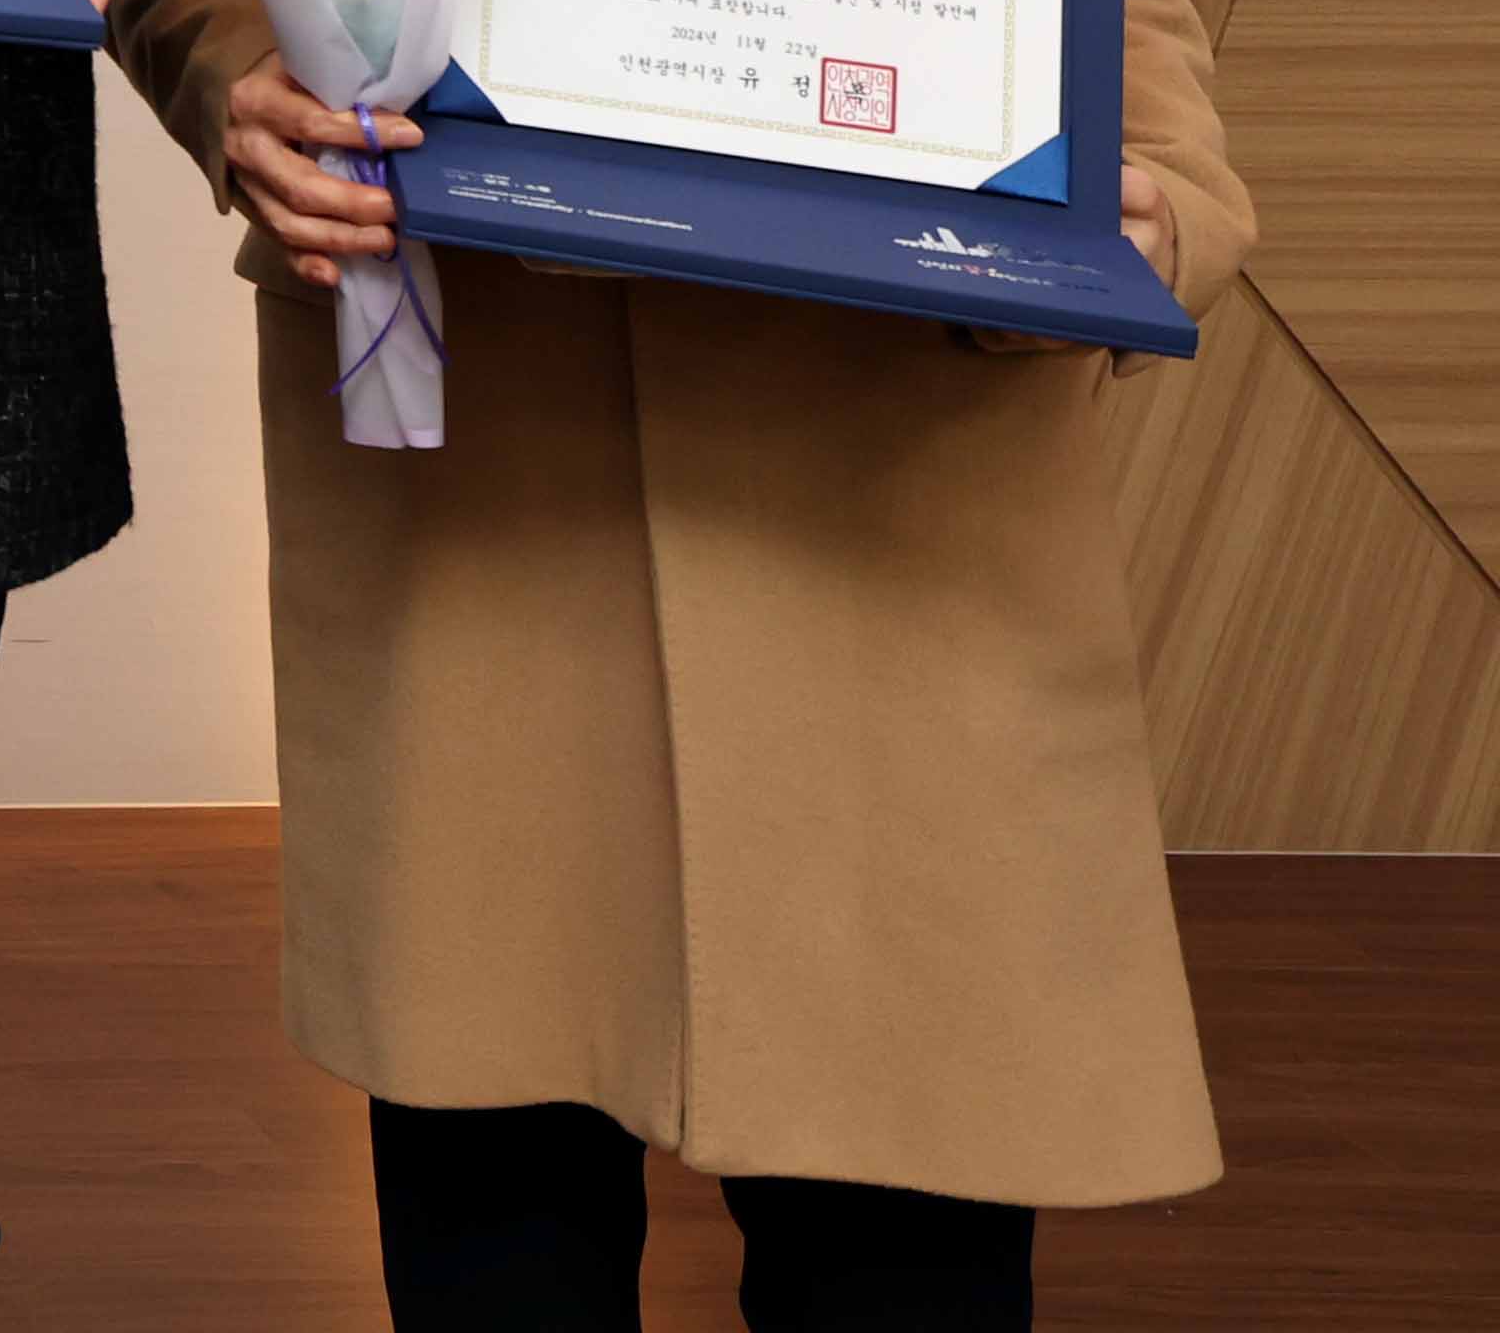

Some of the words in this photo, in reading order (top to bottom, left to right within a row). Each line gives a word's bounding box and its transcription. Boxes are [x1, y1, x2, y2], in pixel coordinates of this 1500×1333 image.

[670, 25, 717, 46] 2024년
[736, 34, 767, 53] 11월
[784, 40, 819, 60] 22일
[618, 53, 727, 85] 인천광역시장
